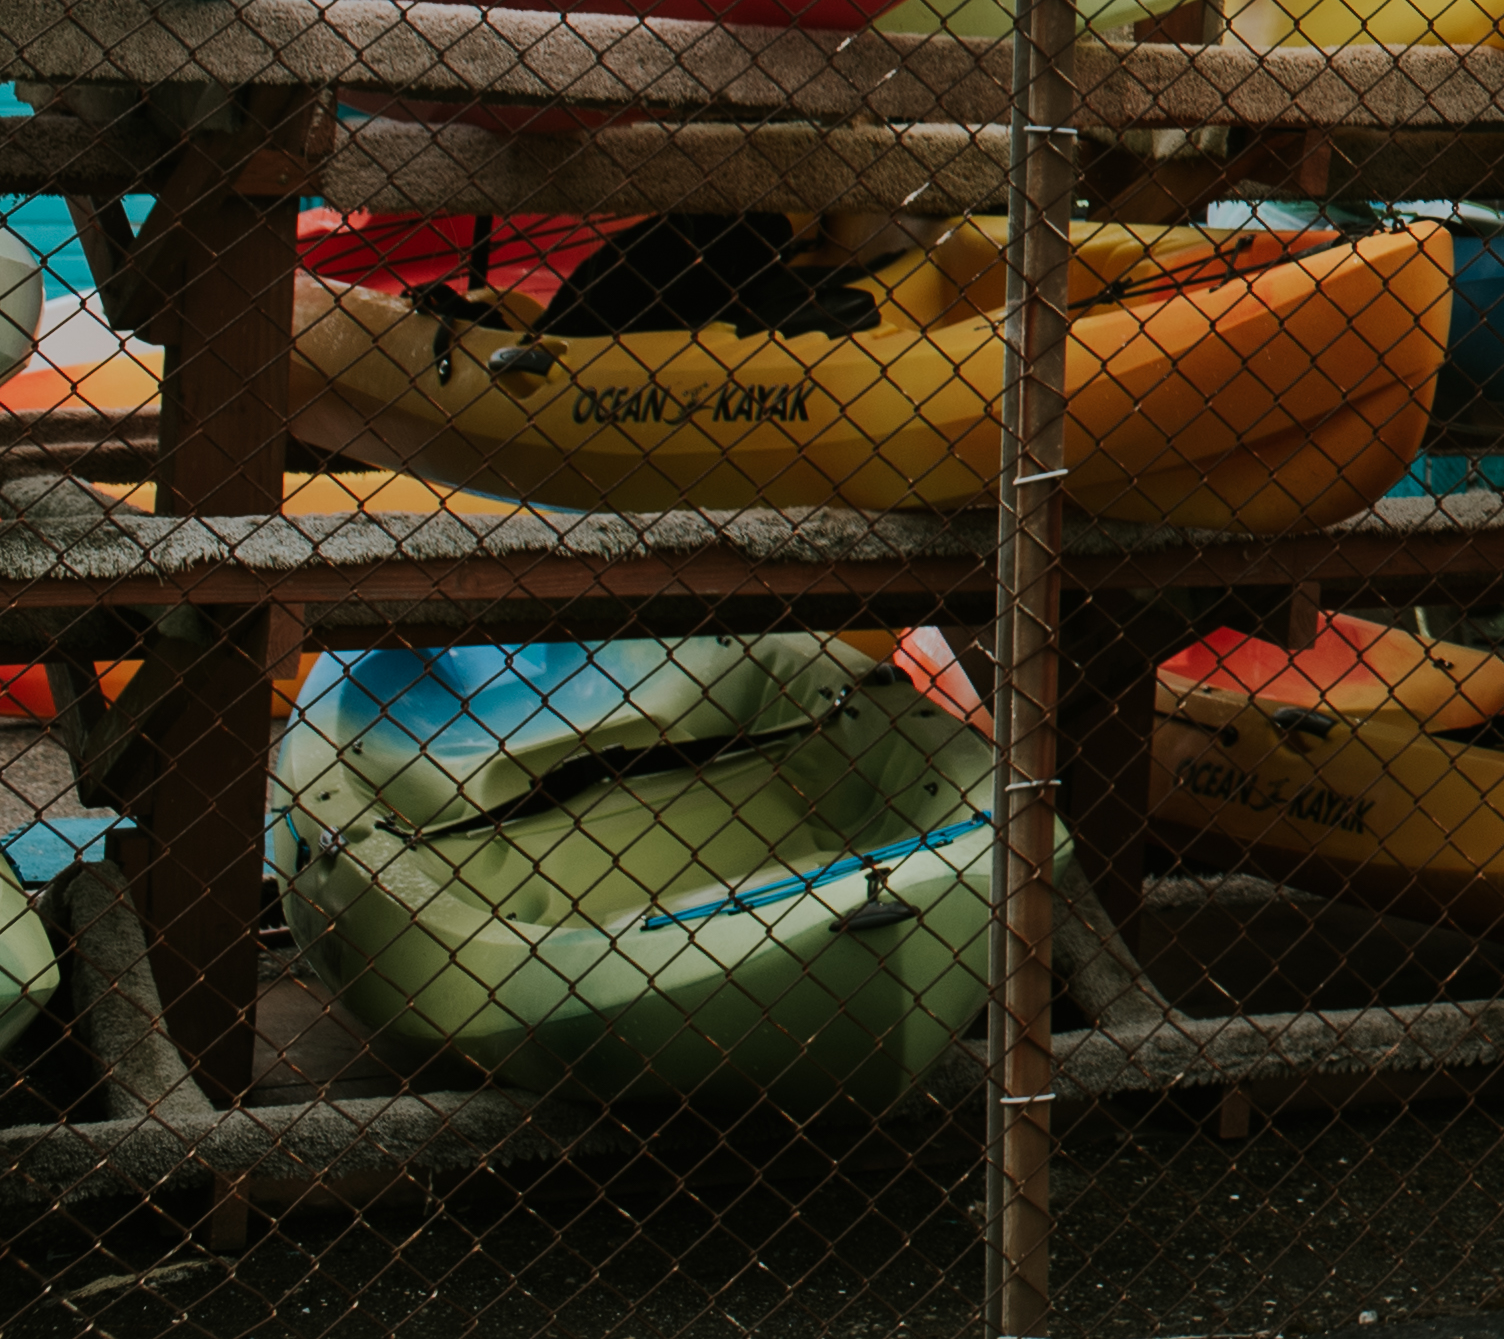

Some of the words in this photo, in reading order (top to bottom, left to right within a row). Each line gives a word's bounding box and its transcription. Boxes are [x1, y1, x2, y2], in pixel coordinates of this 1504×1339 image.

[572, 385, 670, 424] OCEAN
[712, 383, 817, 422] KAYAK
[1172, 756, 1259, 806] OCEAN
[1287, 782, 1376, 835] KAYAK
